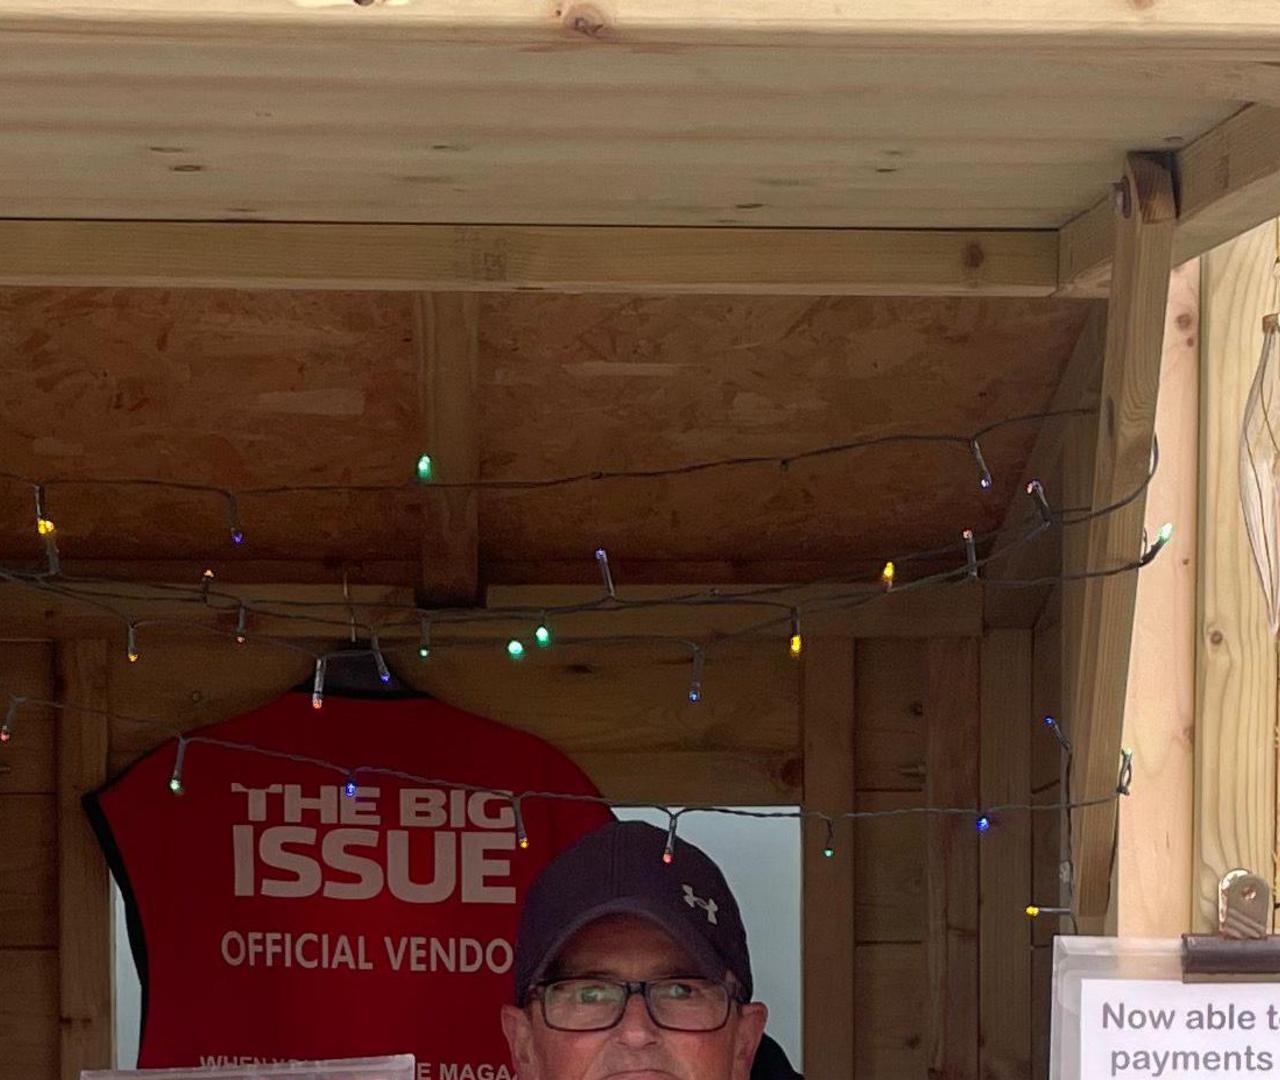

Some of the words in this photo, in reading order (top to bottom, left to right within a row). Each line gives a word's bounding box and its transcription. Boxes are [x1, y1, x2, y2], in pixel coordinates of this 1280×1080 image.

[231, 783, 381, 825] THE
[399, 788, 516, 828] BIG
[232, 824, 516, 904] ISSUE
[221, 931, 373, 970] OFFICIAL
[384, 936, 513, 974] VENDO
[1102, 1002, 1174, 1030] Now
[1186, 1003, 1256, 1030] able
[1111, 1045, 1273, 1076] payments
